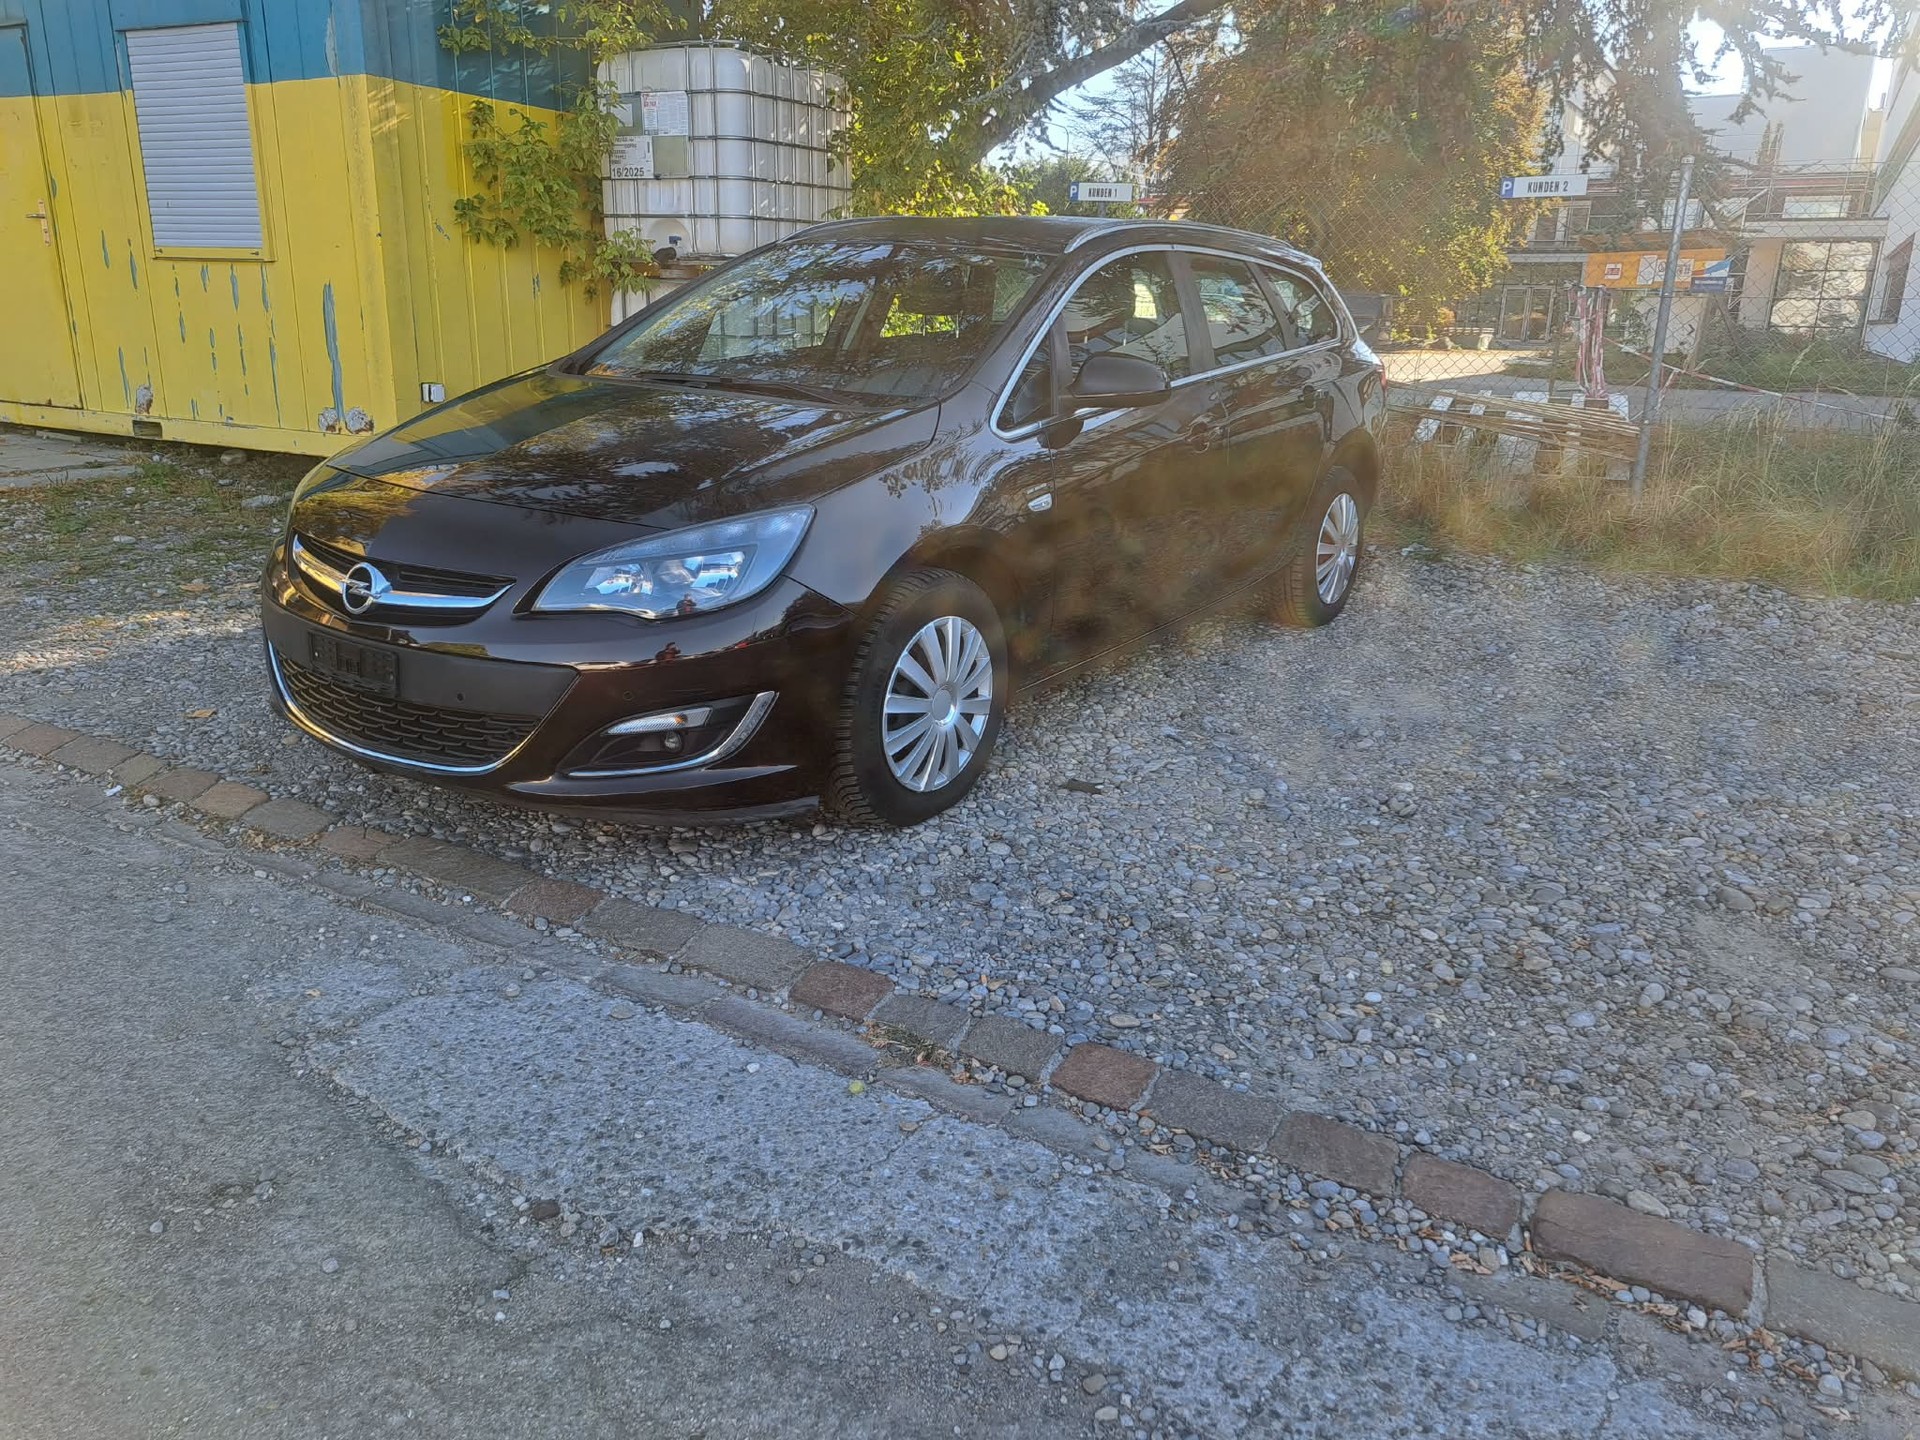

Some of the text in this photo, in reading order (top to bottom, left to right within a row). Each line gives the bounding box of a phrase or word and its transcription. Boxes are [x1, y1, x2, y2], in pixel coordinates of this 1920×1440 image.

[612, 167, 645, 178] 16/2025
[1070, 185, 1077, 198] P
[1501, 180, 1569, 195] P KUNDEN 2
